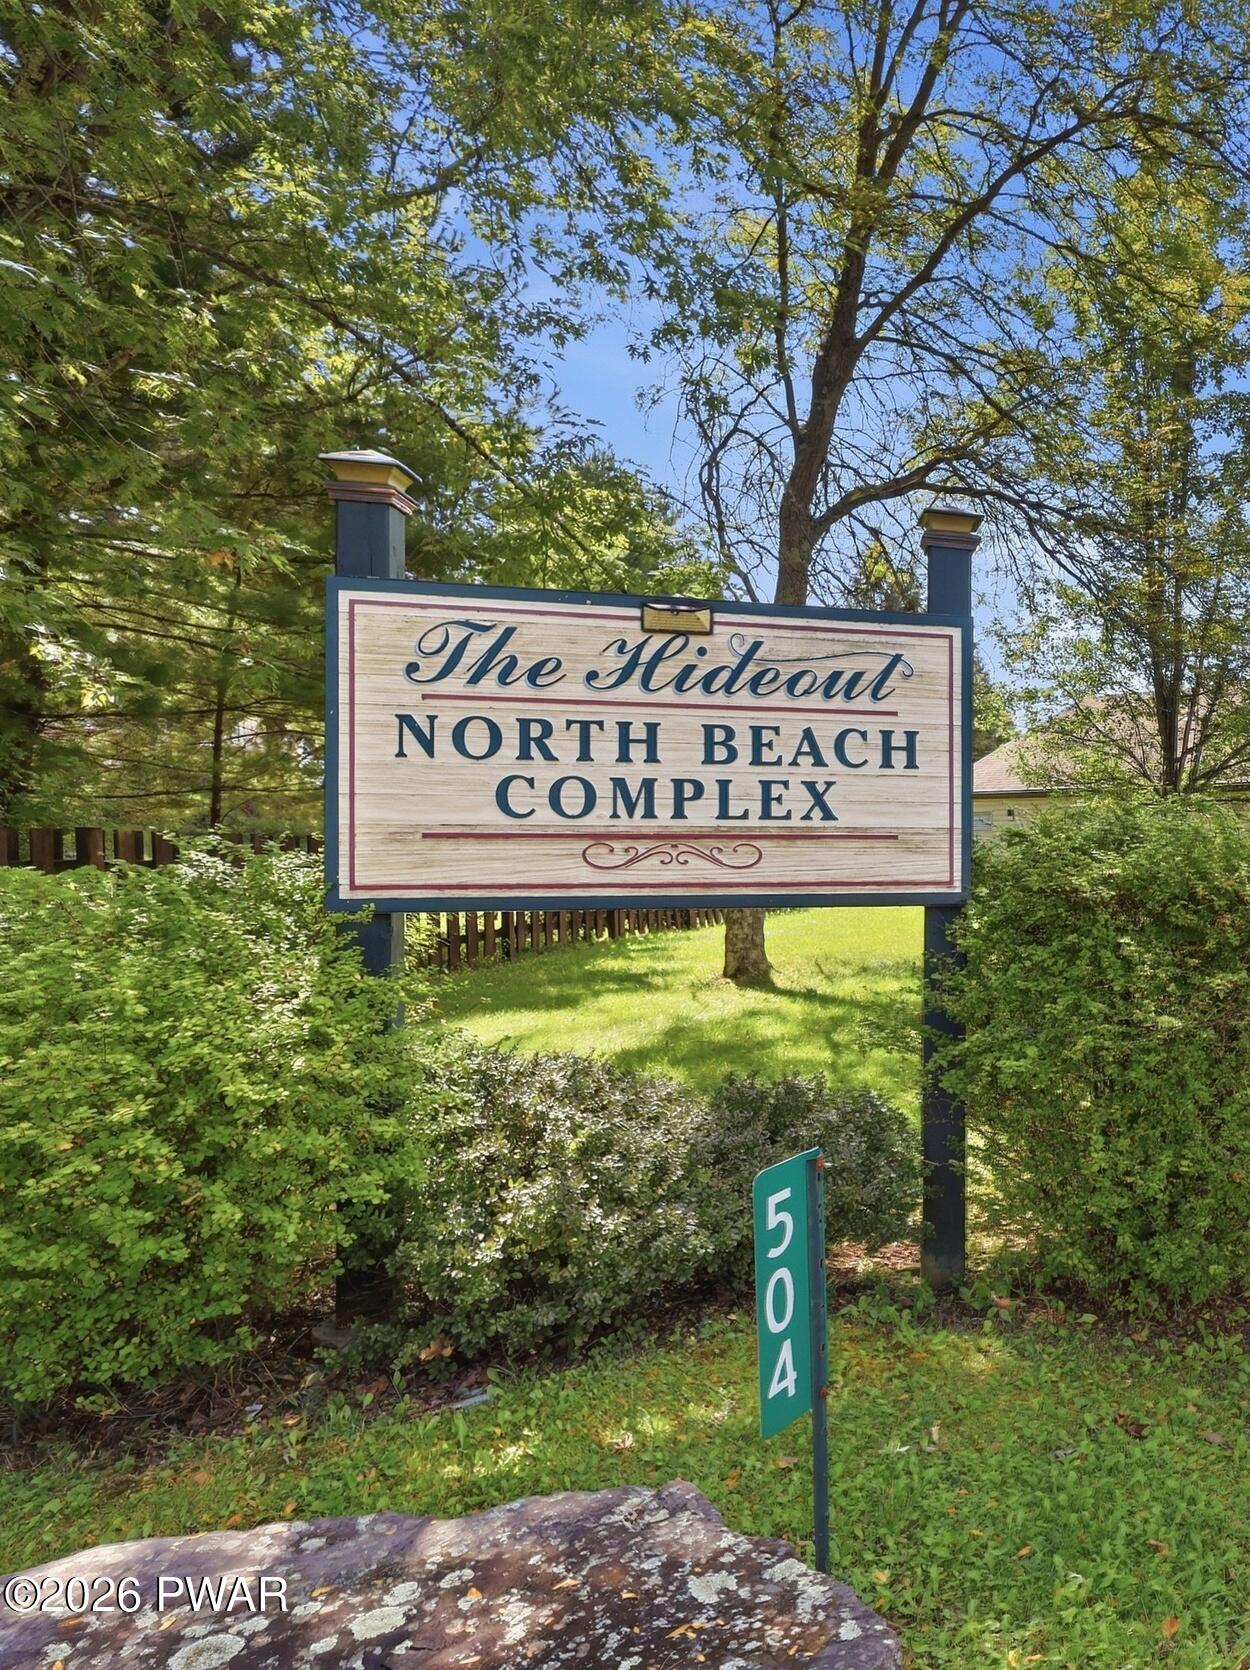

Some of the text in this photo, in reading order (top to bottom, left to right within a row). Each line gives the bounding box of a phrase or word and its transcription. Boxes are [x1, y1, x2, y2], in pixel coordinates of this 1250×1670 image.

[404, 618, 915, 703] The Hideout
[394, 713, 920, 770] NORTH BEACH
[495, 774, 840, 821] COMPLEX
[765, 1187, 798, 1400] 504
